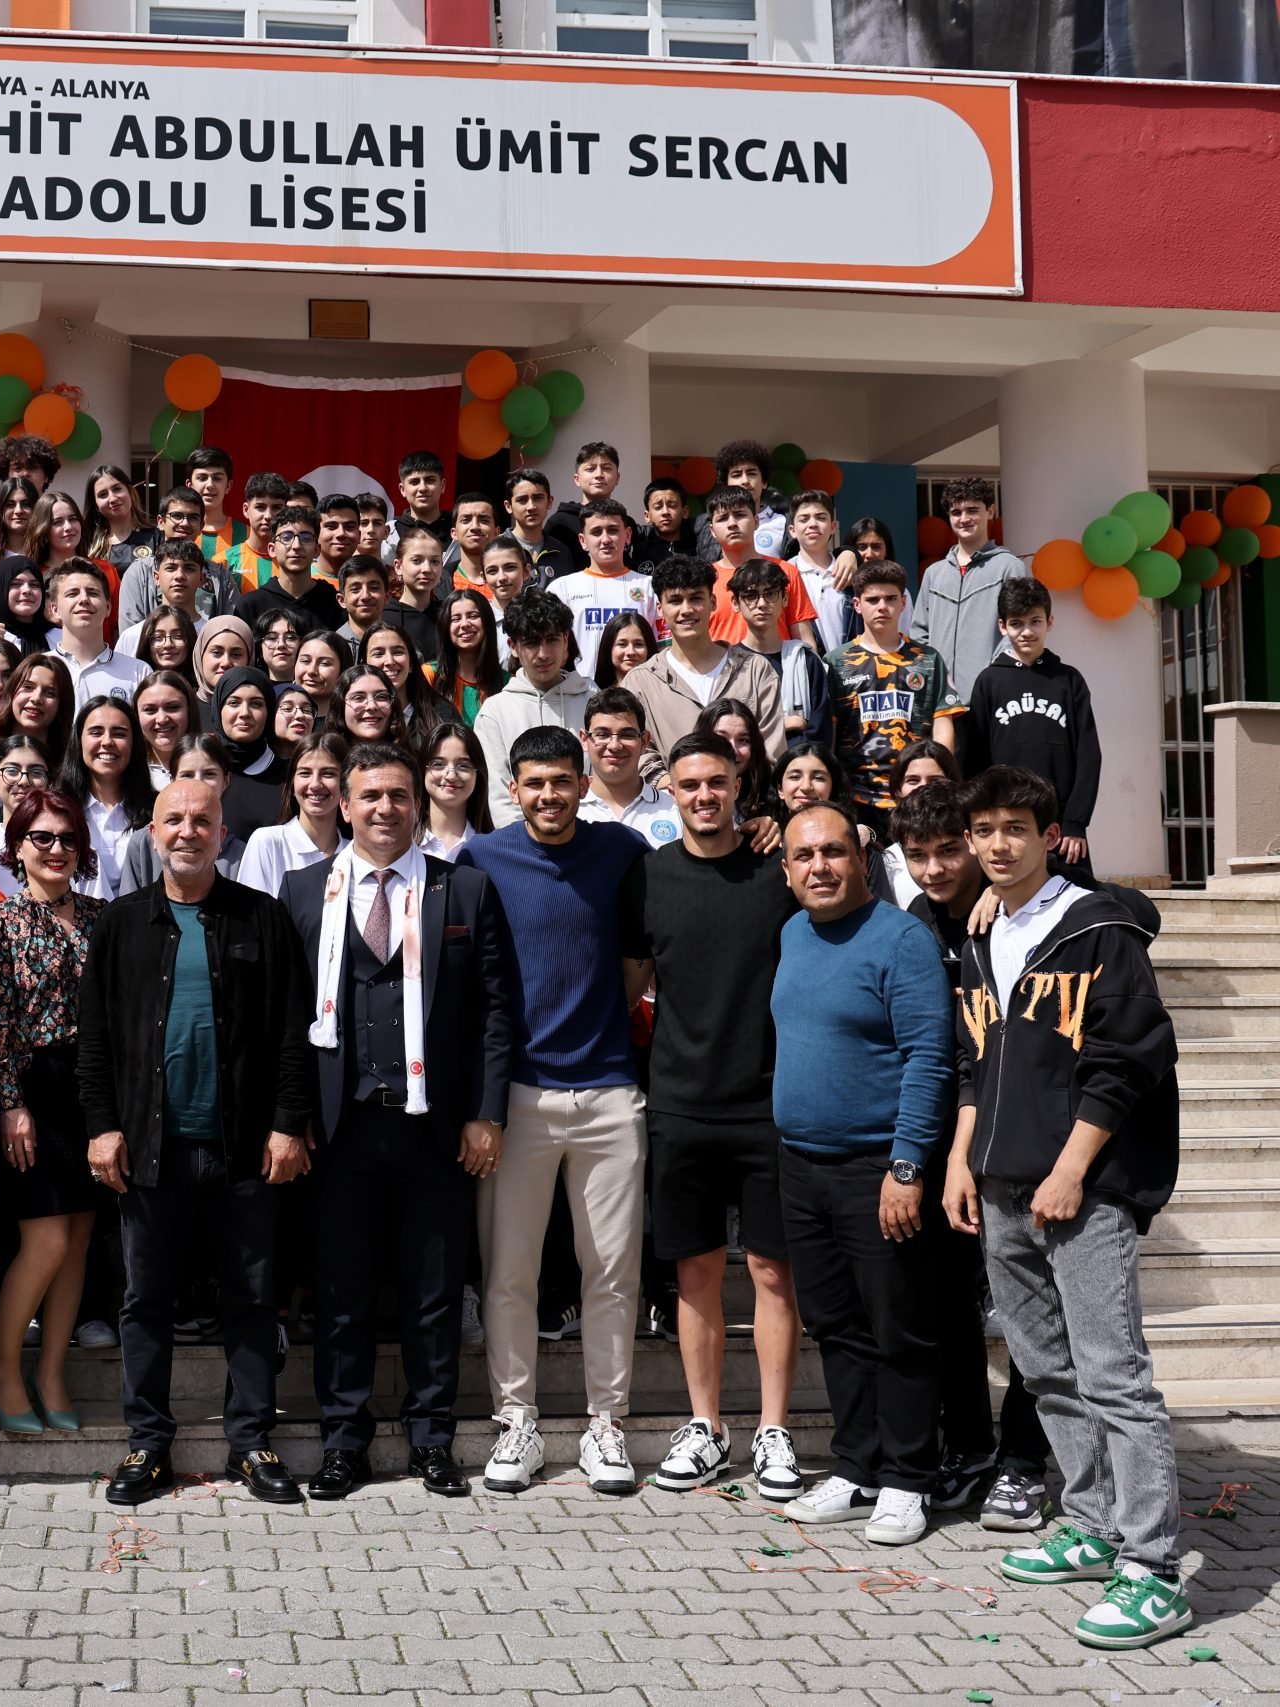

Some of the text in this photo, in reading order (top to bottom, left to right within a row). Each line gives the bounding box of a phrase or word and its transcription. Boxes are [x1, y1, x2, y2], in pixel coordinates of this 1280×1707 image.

[50, 78, 150, 100] ALANYA
[109, 114, 424, 169] ABDULLAH
[456, 117, 600, 175] ÜMİT
[628, 133, 848, 185] SERCAN
[250, 174, 426, 234] LİSESİ
[864, 695, 908, 710] TAV
